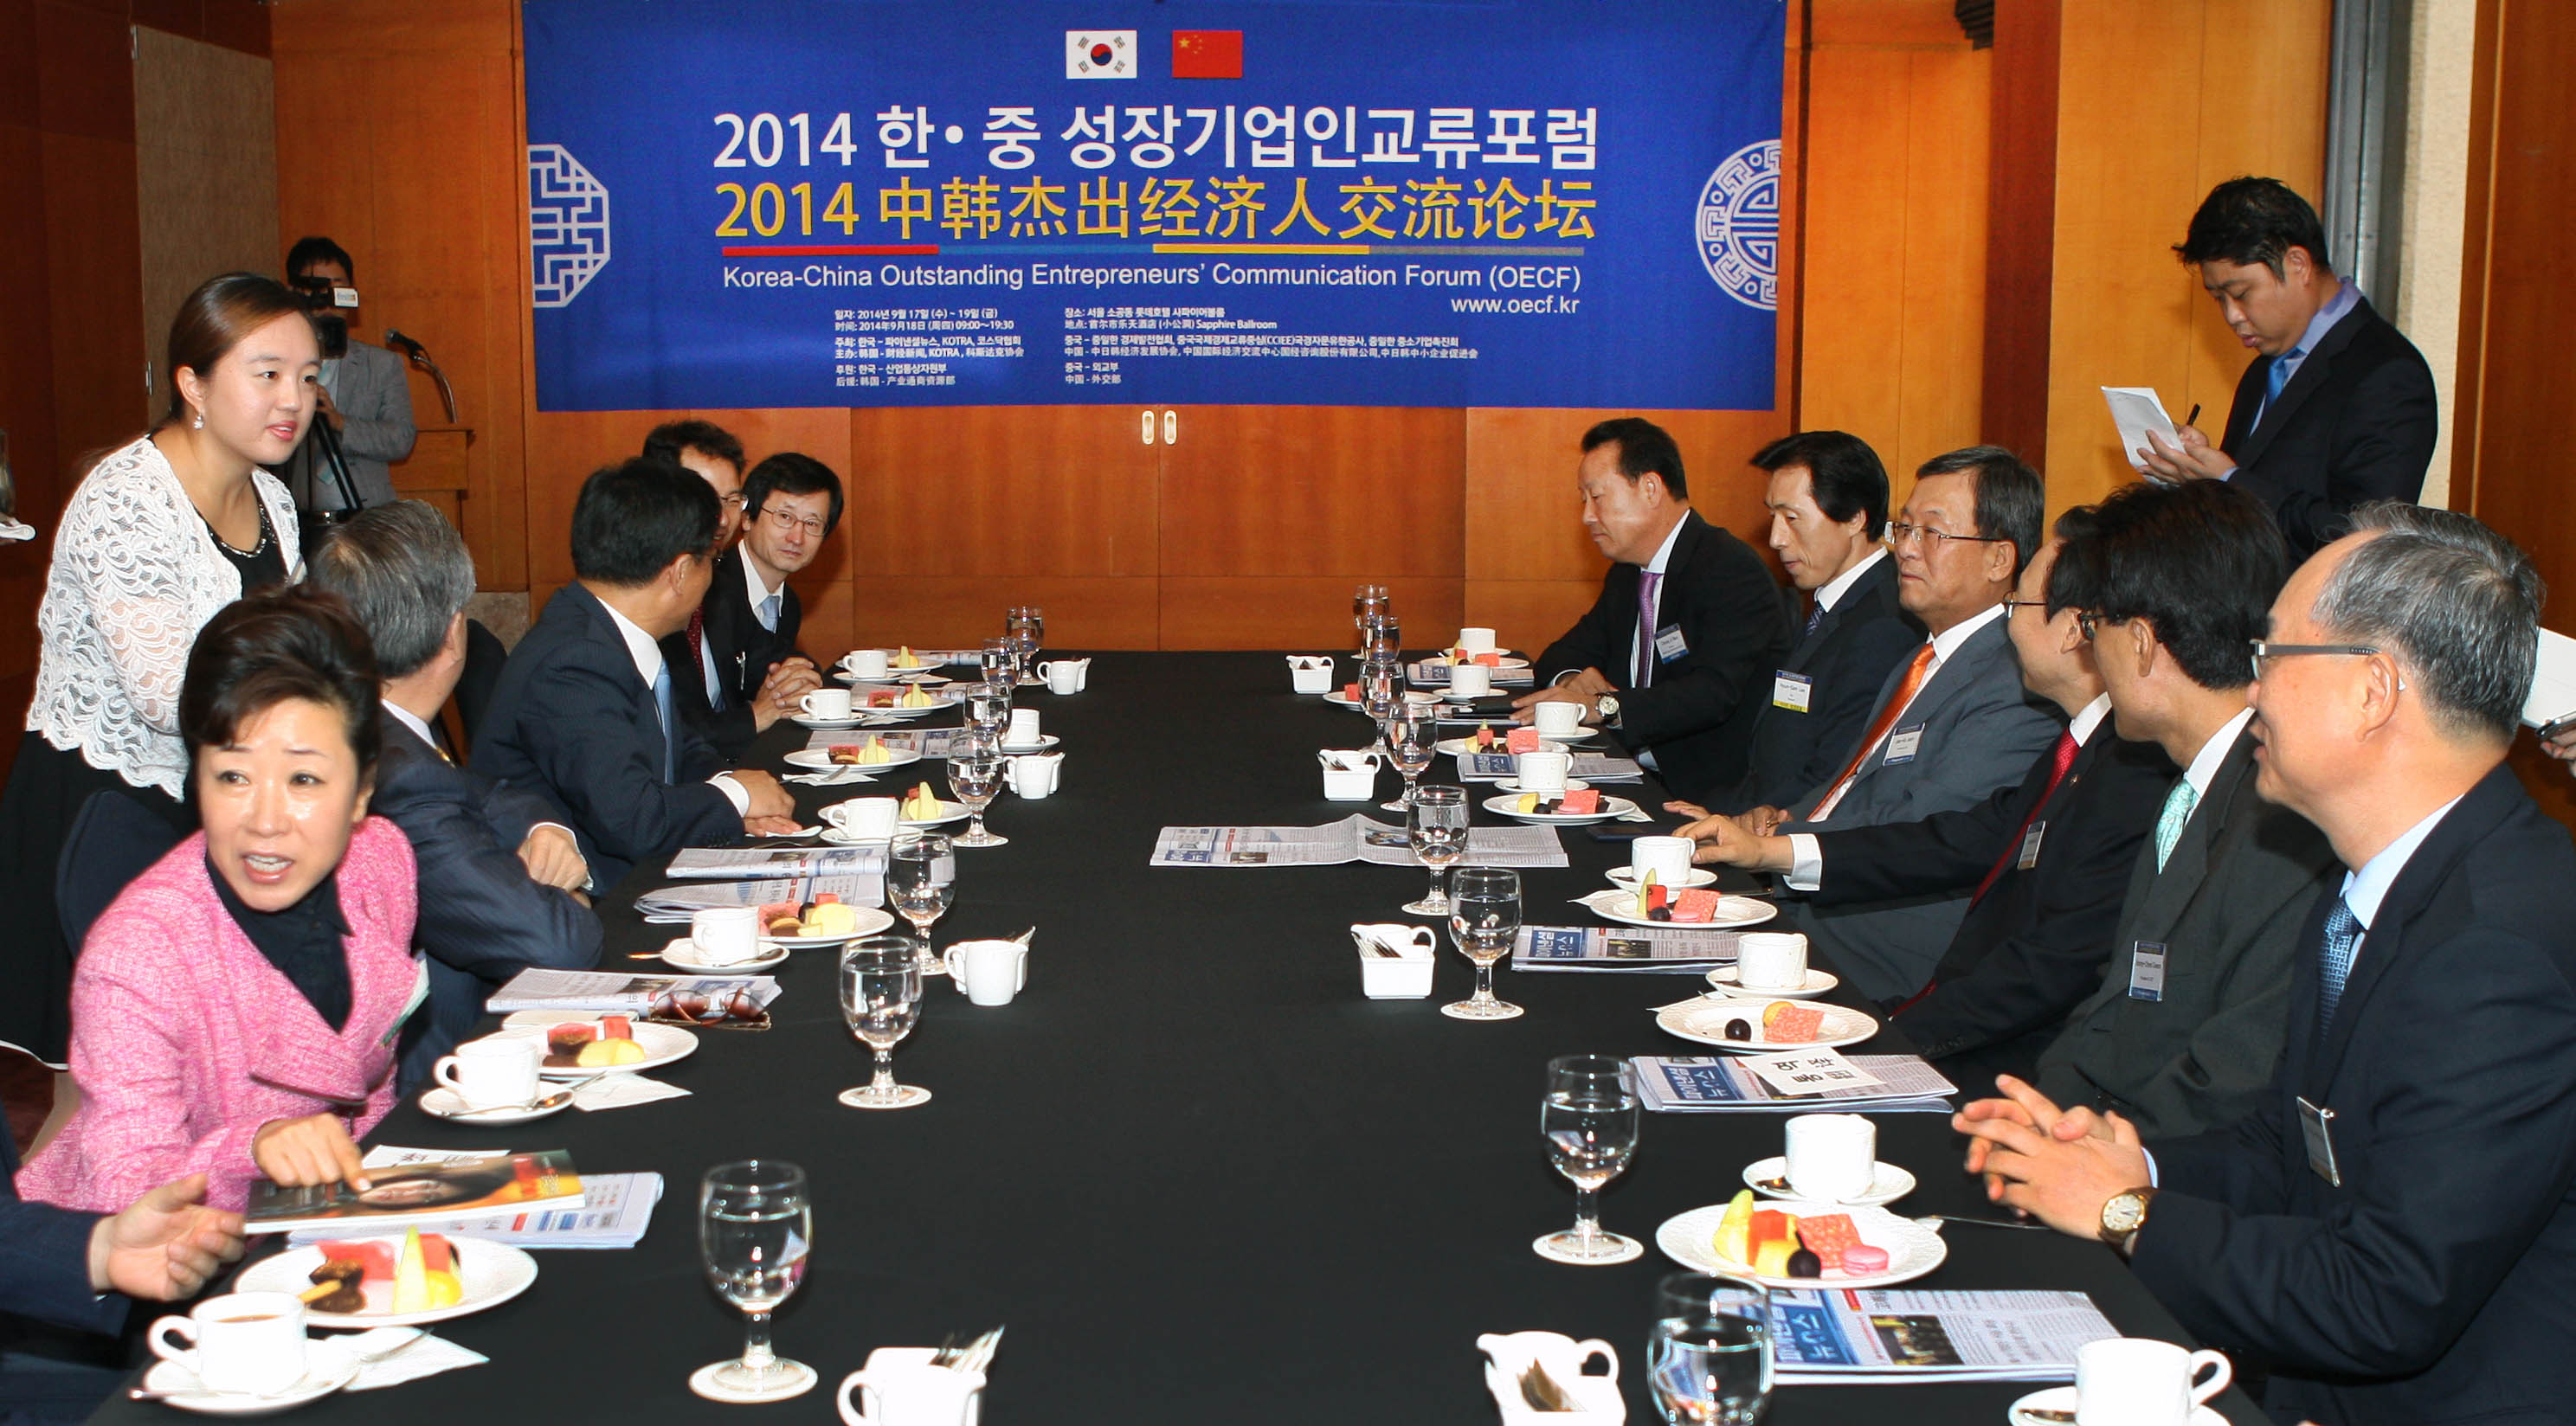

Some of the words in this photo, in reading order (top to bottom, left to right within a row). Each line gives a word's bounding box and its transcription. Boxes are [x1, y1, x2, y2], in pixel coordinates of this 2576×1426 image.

[713, 112, 858, 168] 2014
[978, 106, 1041, 168] 중
[1060, 104, 1597, 170] 성장기업인교류포럼
[715, 181, 860, 238] 2014
[879, 175, 1597, 241] 中韩杰出经济人交流论坛
[724, 265, 873, 287] Korea-China
[880, 264, 1023, 291] Outstanding
[1213, 263, 1396, 286] Communication
[1405, 265, 1481, 286] Forum
[1490, 265, 1581, 292] (OECF)
[1451, 294, 1581, 313] www.oecf.kr
[858, 309, 890, 320] 2014년
[909, 309, 930, 319] 17일
[931, 308, 948, 319] (수)
[959, 308, 980, 319] 19일
[982, 307, 998, 319] (금)
[1087, 306, 1105, 318] 서울
[1196, 319, 1237, 331] Sapphire
[1237, 319, 1278, 331] Ballroom
[857, 336, 877, 347] 한국
[1064, 334, 1083, 345] 중국
[1064, 346, 1084, 356] 中国
[858, 363, 877, 375] 한국
[1065, 362, 1084, 373] 중국
[1092, 362, 1119, 373] 외교부
[1065, 373, 1085, 384] 中国
